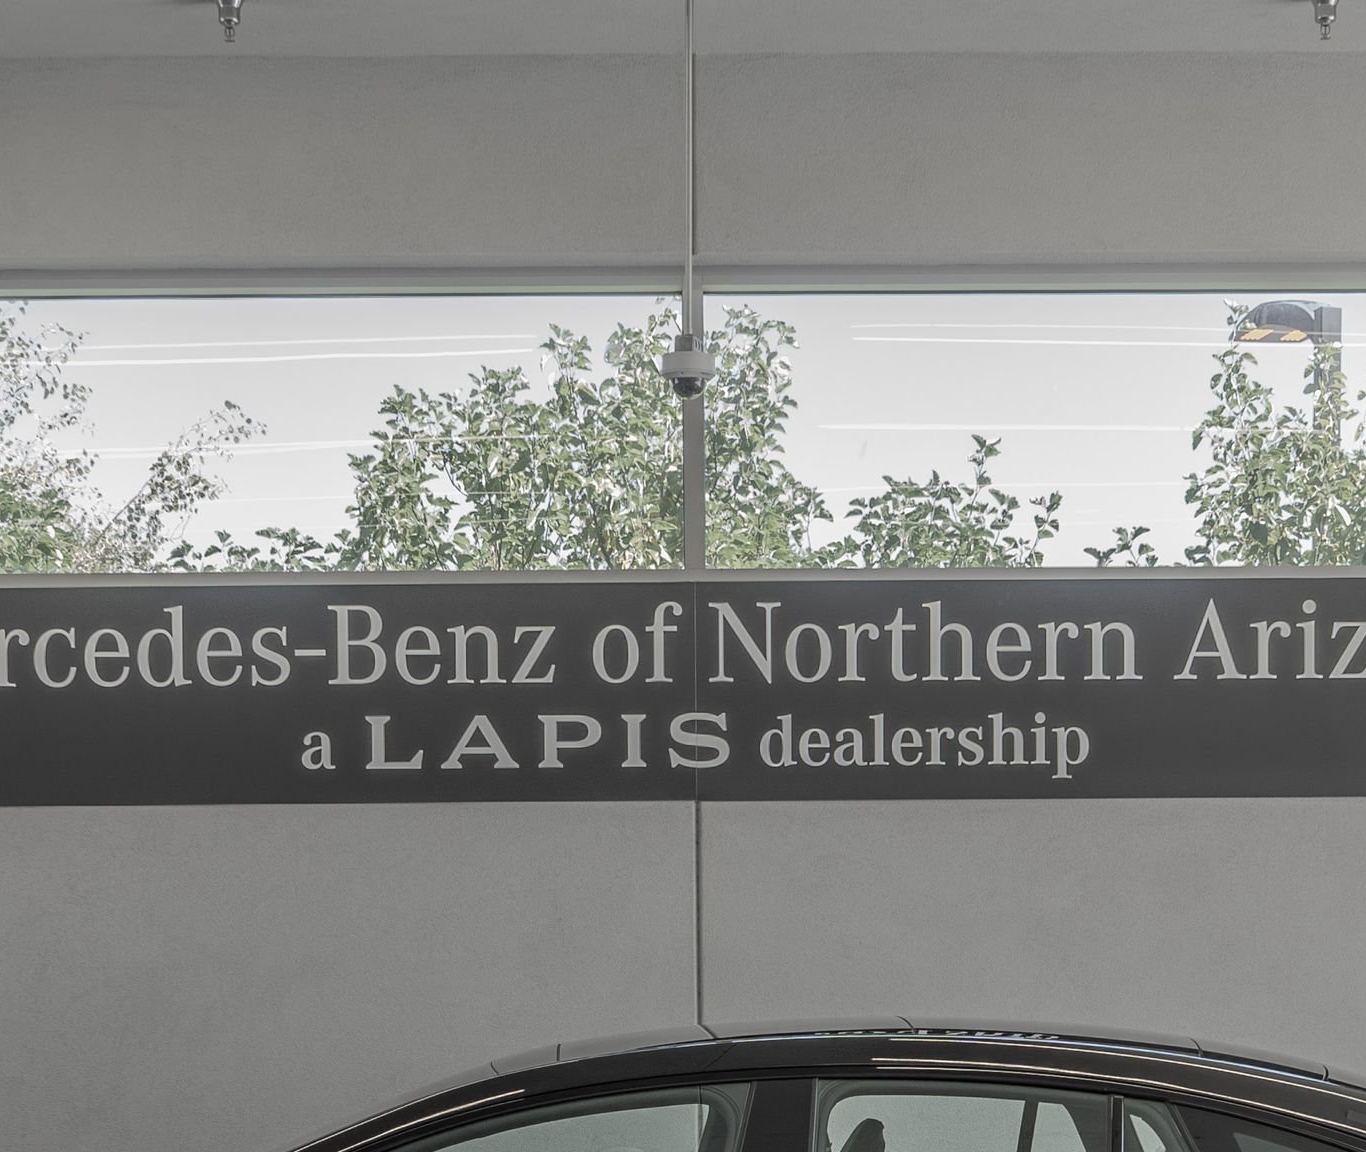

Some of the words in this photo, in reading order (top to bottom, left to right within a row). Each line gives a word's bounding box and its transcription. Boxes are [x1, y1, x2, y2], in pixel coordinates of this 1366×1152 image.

[592, 601, 683, 684] of
[707, 599, 1144, 685] Northern
[301, 731, 336, 770] a
[364, 712, 730, 770] LAPIS
[759, 711, 1090, 779] dealership
